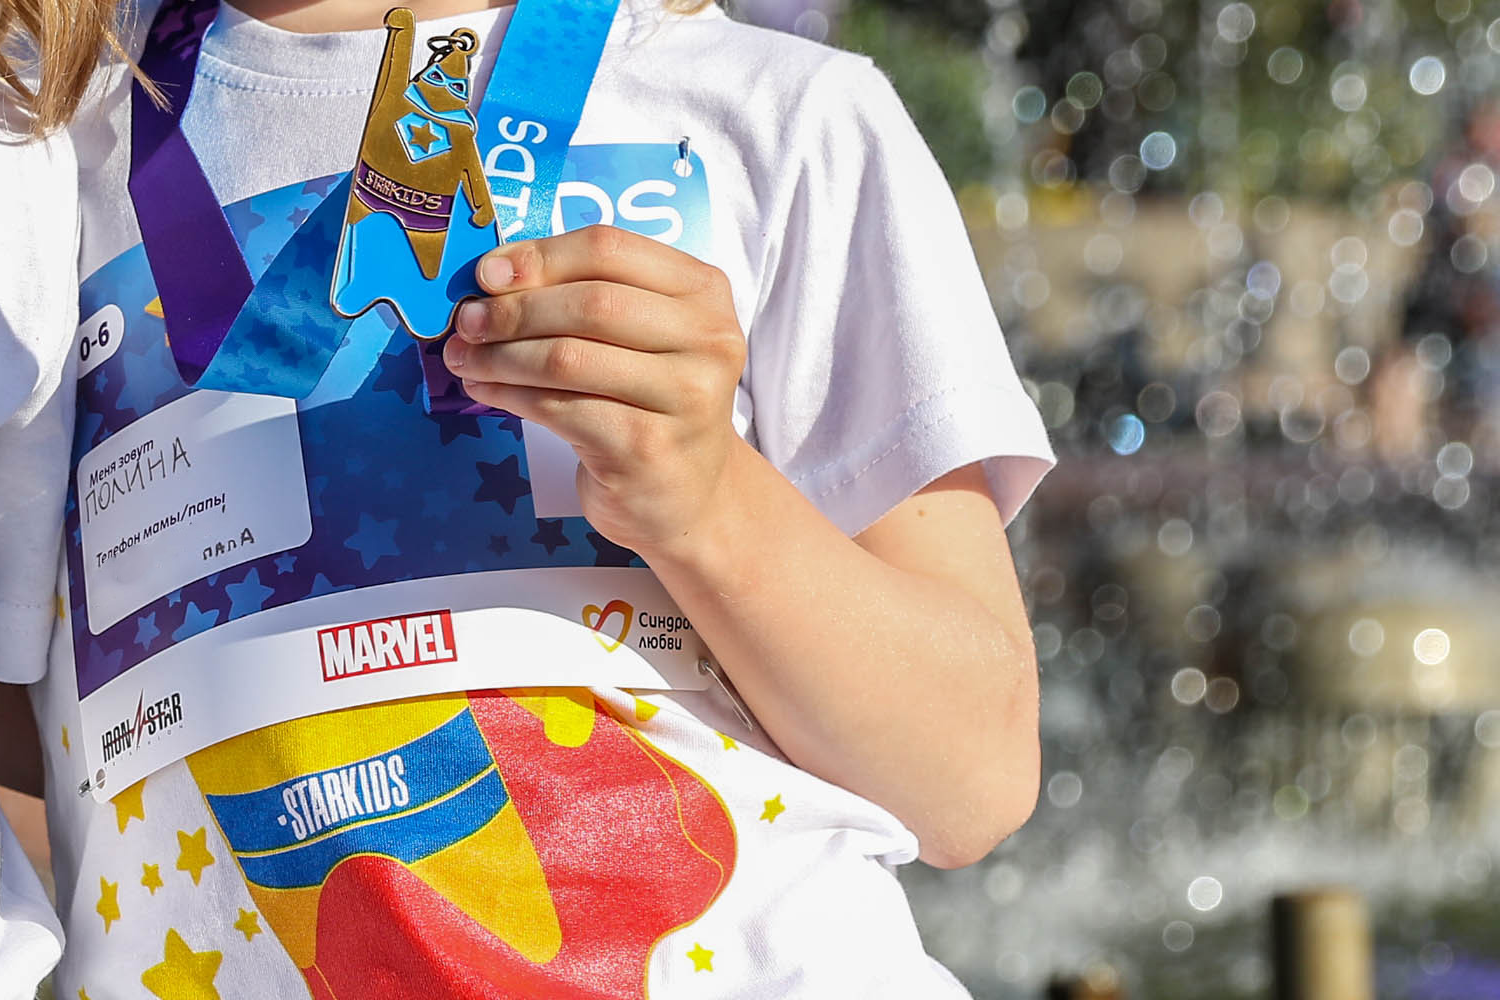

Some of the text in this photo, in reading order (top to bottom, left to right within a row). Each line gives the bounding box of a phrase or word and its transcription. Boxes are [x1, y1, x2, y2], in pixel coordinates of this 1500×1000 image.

[366, 170, 442, 210] STARKIDS
[80, 321, 109, 361] 0-6
[85, 437, 191, 523] ПОЛИНА
[89, 439, 154, 488] Меня зовут
[96, 493, 226, 568] Телефон мамы/папы
[321, 613, 454, 678] MARVEL
[639, 612, 693, 633] Синдро
[639, 634, 682, 650] любви
[101, 719, 132, 763] IRON
[146, 692, 182, 735] STAR
[282, 754, 410, 840] STARKIDS
